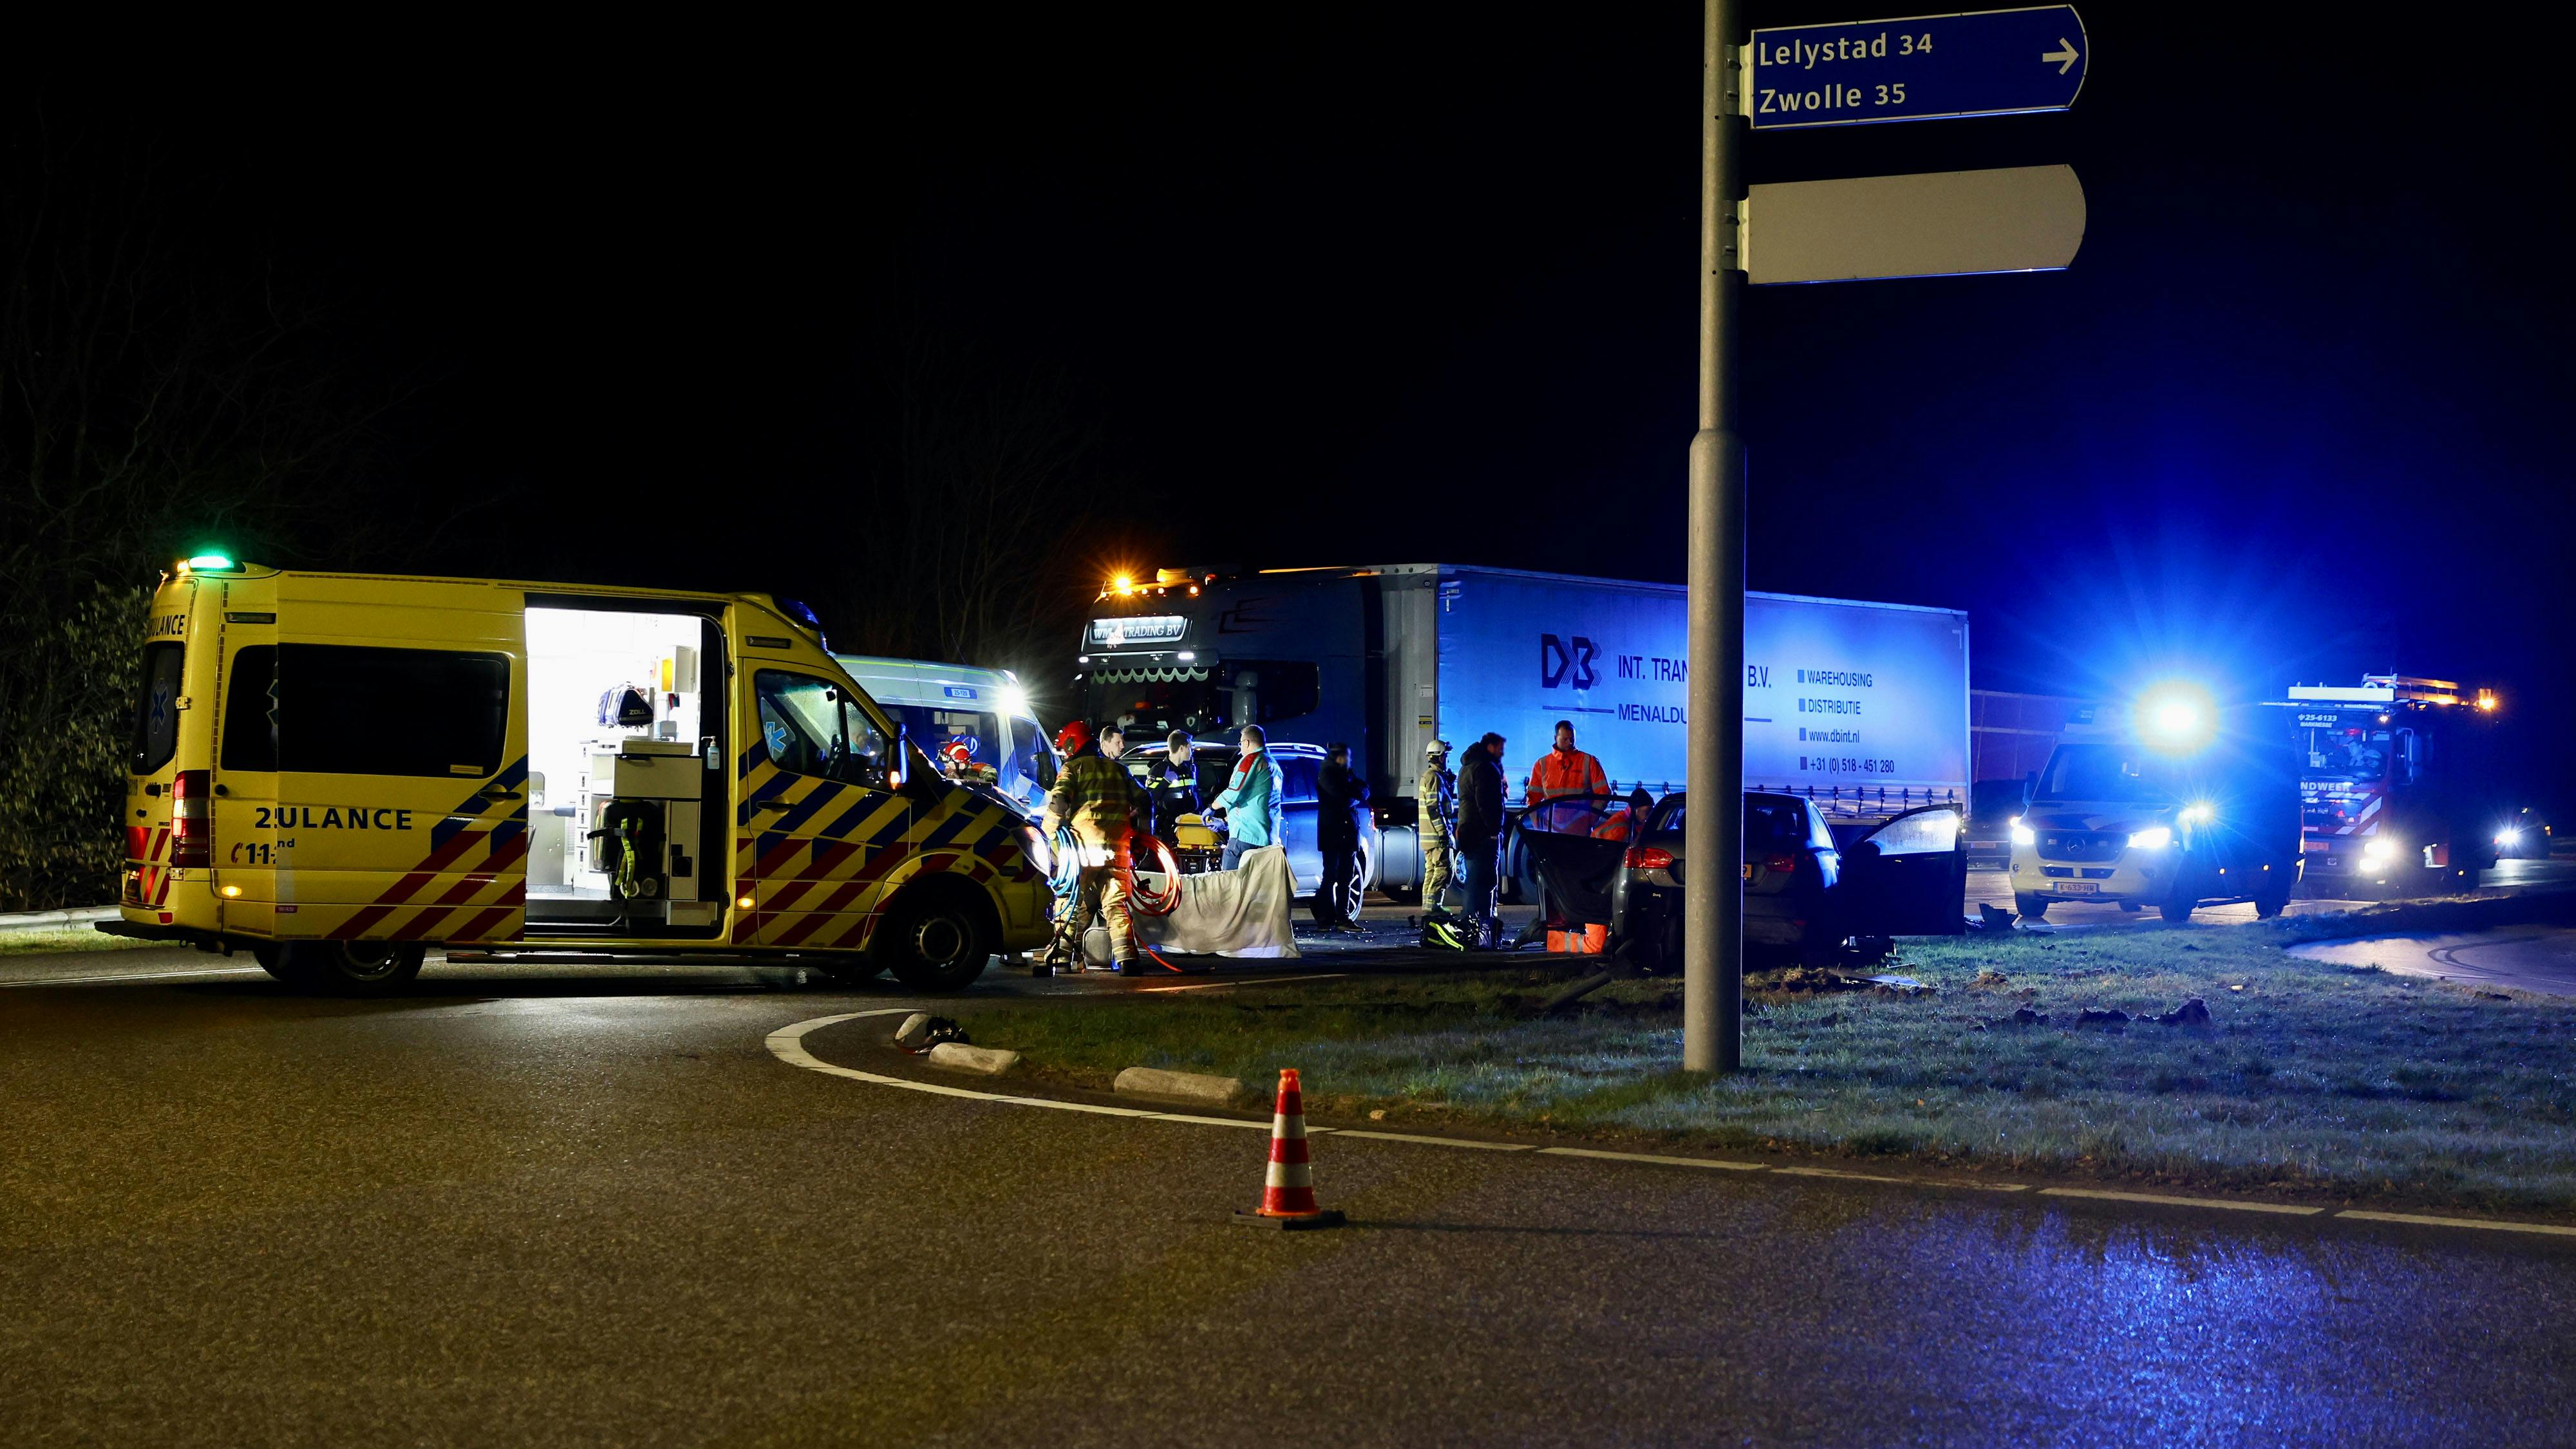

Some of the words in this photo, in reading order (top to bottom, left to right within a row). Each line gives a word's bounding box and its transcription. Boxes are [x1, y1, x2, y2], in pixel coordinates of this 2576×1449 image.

[1760, 32, 1886, 69] Lelystad
[1899, 33, 1933, 55] 34
[1760, 84, 1862, 113] Zwolle
[1874, 84, 1906, 105] 35
[1124, 626, 1163, 637] TRADING
[1166, 624, 1181, 636] BV
[1618, 655, 1646, 680] INT.
[1747, 665, 1771, 688] B.V.
[1807, 669, 1872, 687] WAREHOUSING
[1809, 698, 1861, 715] DISTRIBUTIE
[1809, 729, 1859, 743] www.dbint.nl
[1810, 758, 1825, 771] +31
[1829, 757, 1839, 774] (0)
[1842, 758, 1856, 772] 518
[1864, 760, 1877, 772] 451
[1881, 760, 1894, 773] 280
